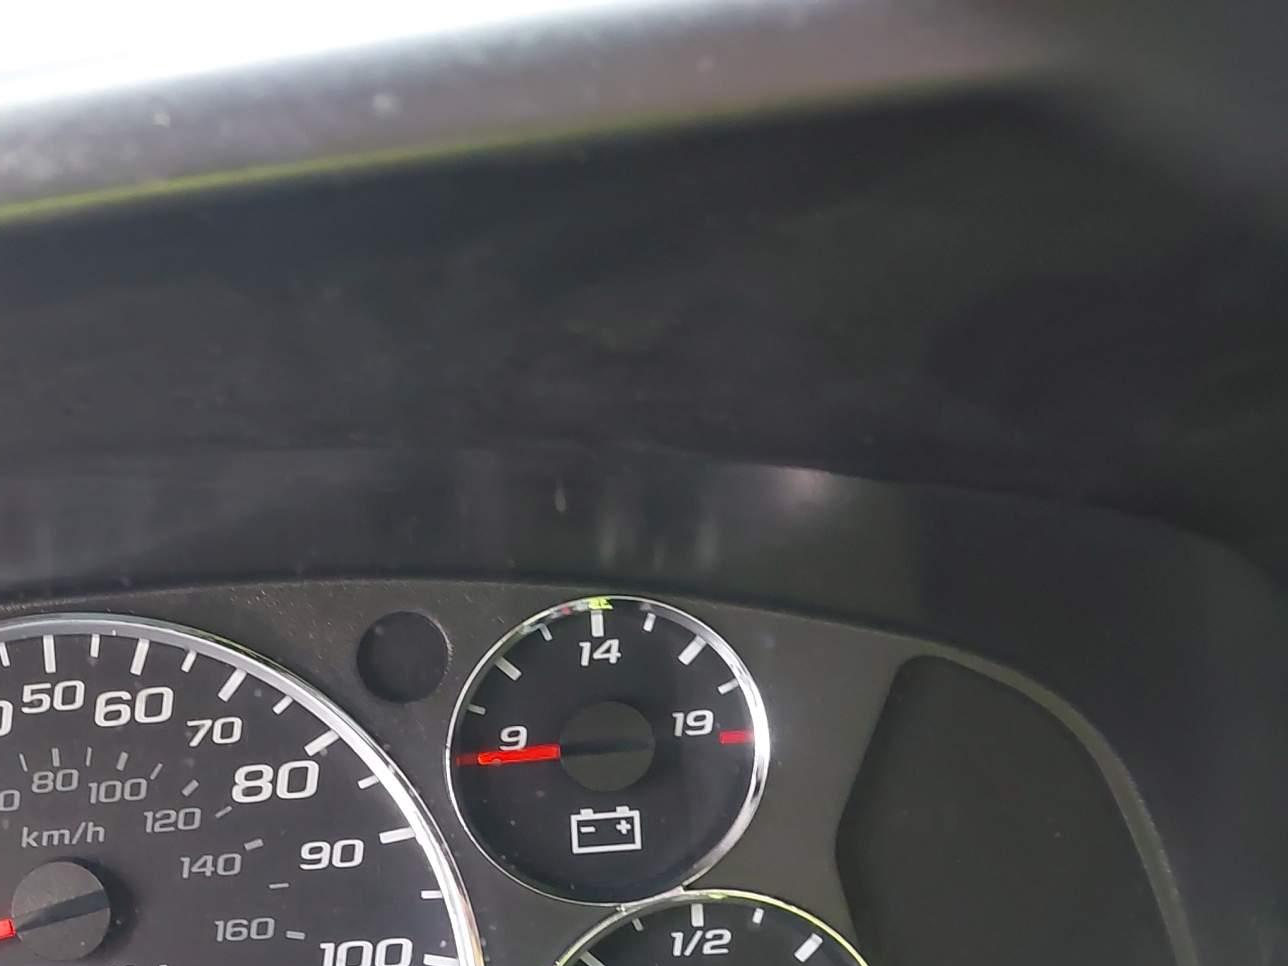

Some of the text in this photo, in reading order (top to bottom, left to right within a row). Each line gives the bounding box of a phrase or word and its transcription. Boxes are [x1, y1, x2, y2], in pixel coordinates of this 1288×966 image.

[580, 639, 621, 666] 14
[22, 681, 84, 713] 50
[95, 687, 173, 726] 60
[187, 717, 242, 746] 70
[673, 710, 713, 736] 19
[500, 726, 527, 750] 9
[32, 769, 78, 793] 80
[88, 779, 147, 803] 100
[232, 761, 319, 802] 80
[144, 808, 201, 832] 120
[22, 822, 104, 847] km/h
[181, 854, 241, 878] 140
[300, 840, 363, 869] 90
[215, 918, 274, 941] 160
[672, 930, 731, 956] 1/2
